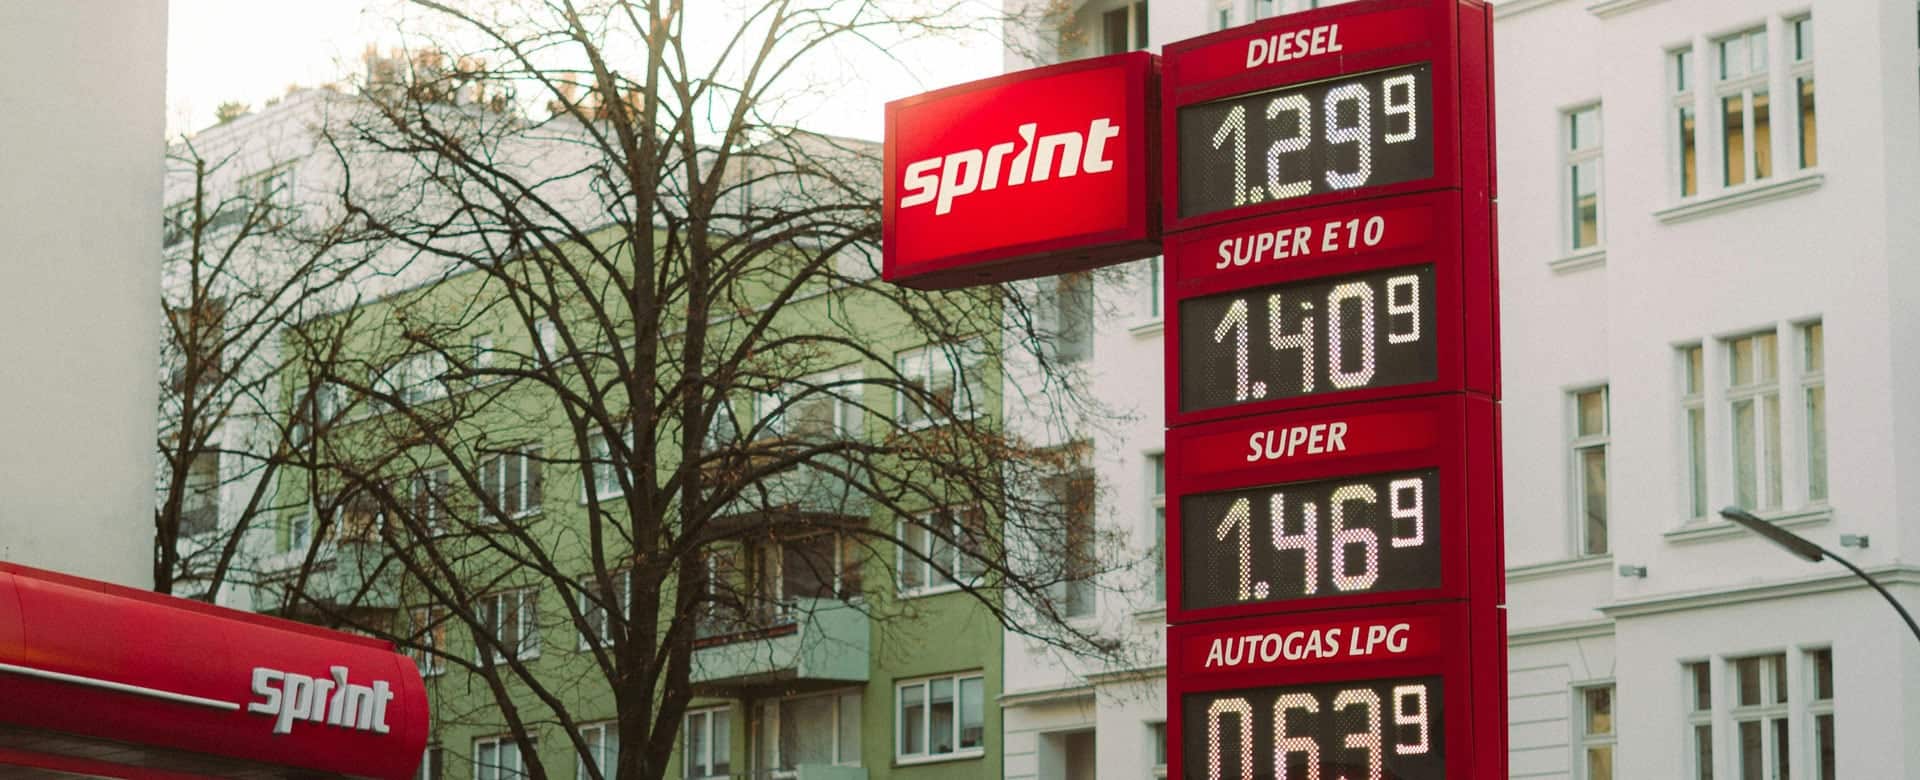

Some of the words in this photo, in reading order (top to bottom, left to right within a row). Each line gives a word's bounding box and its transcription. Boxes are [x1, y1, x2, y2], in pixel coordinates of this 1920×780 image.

[1245, 24, 1344, 69] DIESEL
[900, 117, 1120, 216] sprint
[1216, 226, 1313, 270] SUPER
[1321, 215, 1386, 252] E10
[1246, 421, 1349, 463] SUPER
[1204, 627, 1342, 668] AUTOGAS
[1349, 623, 1411, 656] LPG
[247, 665, 394, 734] sprint
